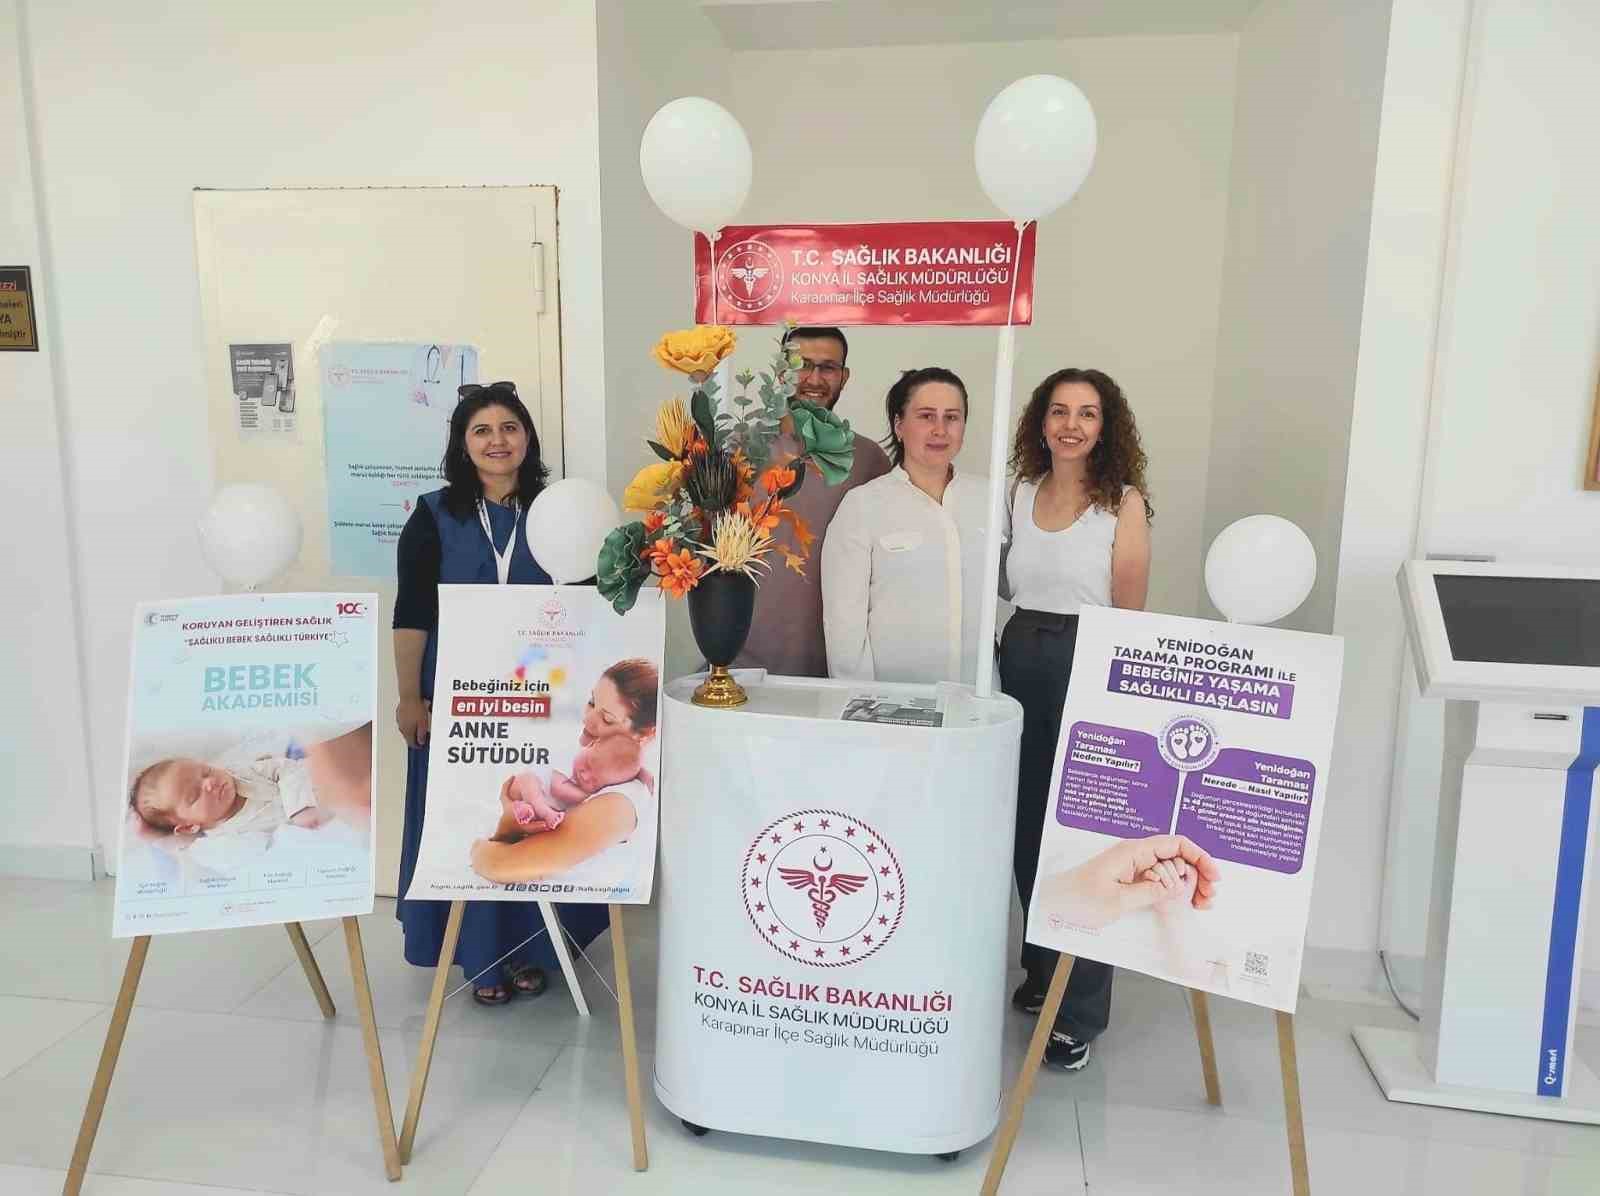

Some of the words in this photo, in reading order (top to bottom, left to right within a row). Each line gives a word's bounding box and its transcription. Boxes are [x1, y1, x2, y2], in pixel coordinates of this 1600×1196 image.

[792, 249, 824, 266] T.C.
[831, 244, 900, 266] SAĞLIK
[905, 242, 1011, 265] BAKANLIĞI
[791, 271, 839, 286] KONYA
[857, 267, 907, 285] SAĞLIK
[911, 267, 1008, 285] MÜDÜRLÜĞÜ
[878, 288, 915, 306] Sağlık
[923, 288, 989, 305] Müdürlüğü
[182, 620, 233, 631] KORUYAN
[296, 615, 332, 626] SAĞLIK
[226, 634, 253, 644] BEBEK
[1156, 637, 1254, 661] YENİDOĞAN
[1114, 646, 1179, 666] TARAMA
[1184, 657, 1274, 679] PROGRAMI
[203, 663, 319, 693] BEBEK
[452, 679, 521, 694] Bebeğiniz
[524, 679, 550, 694] için
[1122, 663, 1203, 687] BEBEĞİNİZ
[1209, 676, 1281, 698] YAŞAMA
[1119, 679, 1190, 702] SAĞLIKLI
[1195, 692, 1279, 715] BAŞLASIN
[456, 701, 476, 713] en
[479, 700, 499, 715] iyi
[502, 701, 545, 713] besin
[449, 721, 509, 739] ANNE
[1077, 730, 1126, 746] Yenidoğan
[447, 743, 550, 765] SÜTÜDÜR
[1074, 741, 1117, 755] Taraması
[1072, 751, 1103, 763] Neden
[1105, 757, 1139, 770] Yapılır?
[1254, 761, 1311, 779] Yenidoğan
[1203, 777, 1238, 789] Nerede
[1248, 785, 1271, 796] Nasıl
[1274, 789, 1308, 802] Yapılır?
[1261, 775, 1309, 790] Taraması
[693, 966, 729, 990] T.C.
[738, 975, 820, 1003] SAĞLIK
[826, 987, 952, 1012] BAKANLIĞI
[694, 992, 748, 1016] KONYA
[751, 999, 765, 1018] İL
[768, 1004, 830, 1025] SAĞLIK
[833, 1011, 949, 1035] MÜDÜRLÜĞÜ
[702, 1014, 771, 1038] Karapınar
[774, 1023, 800, 1044] İlçe
[804, 1029, 849, 1050] Sağlık
[854, 1036, 939, 1058] Müdürlüğü
